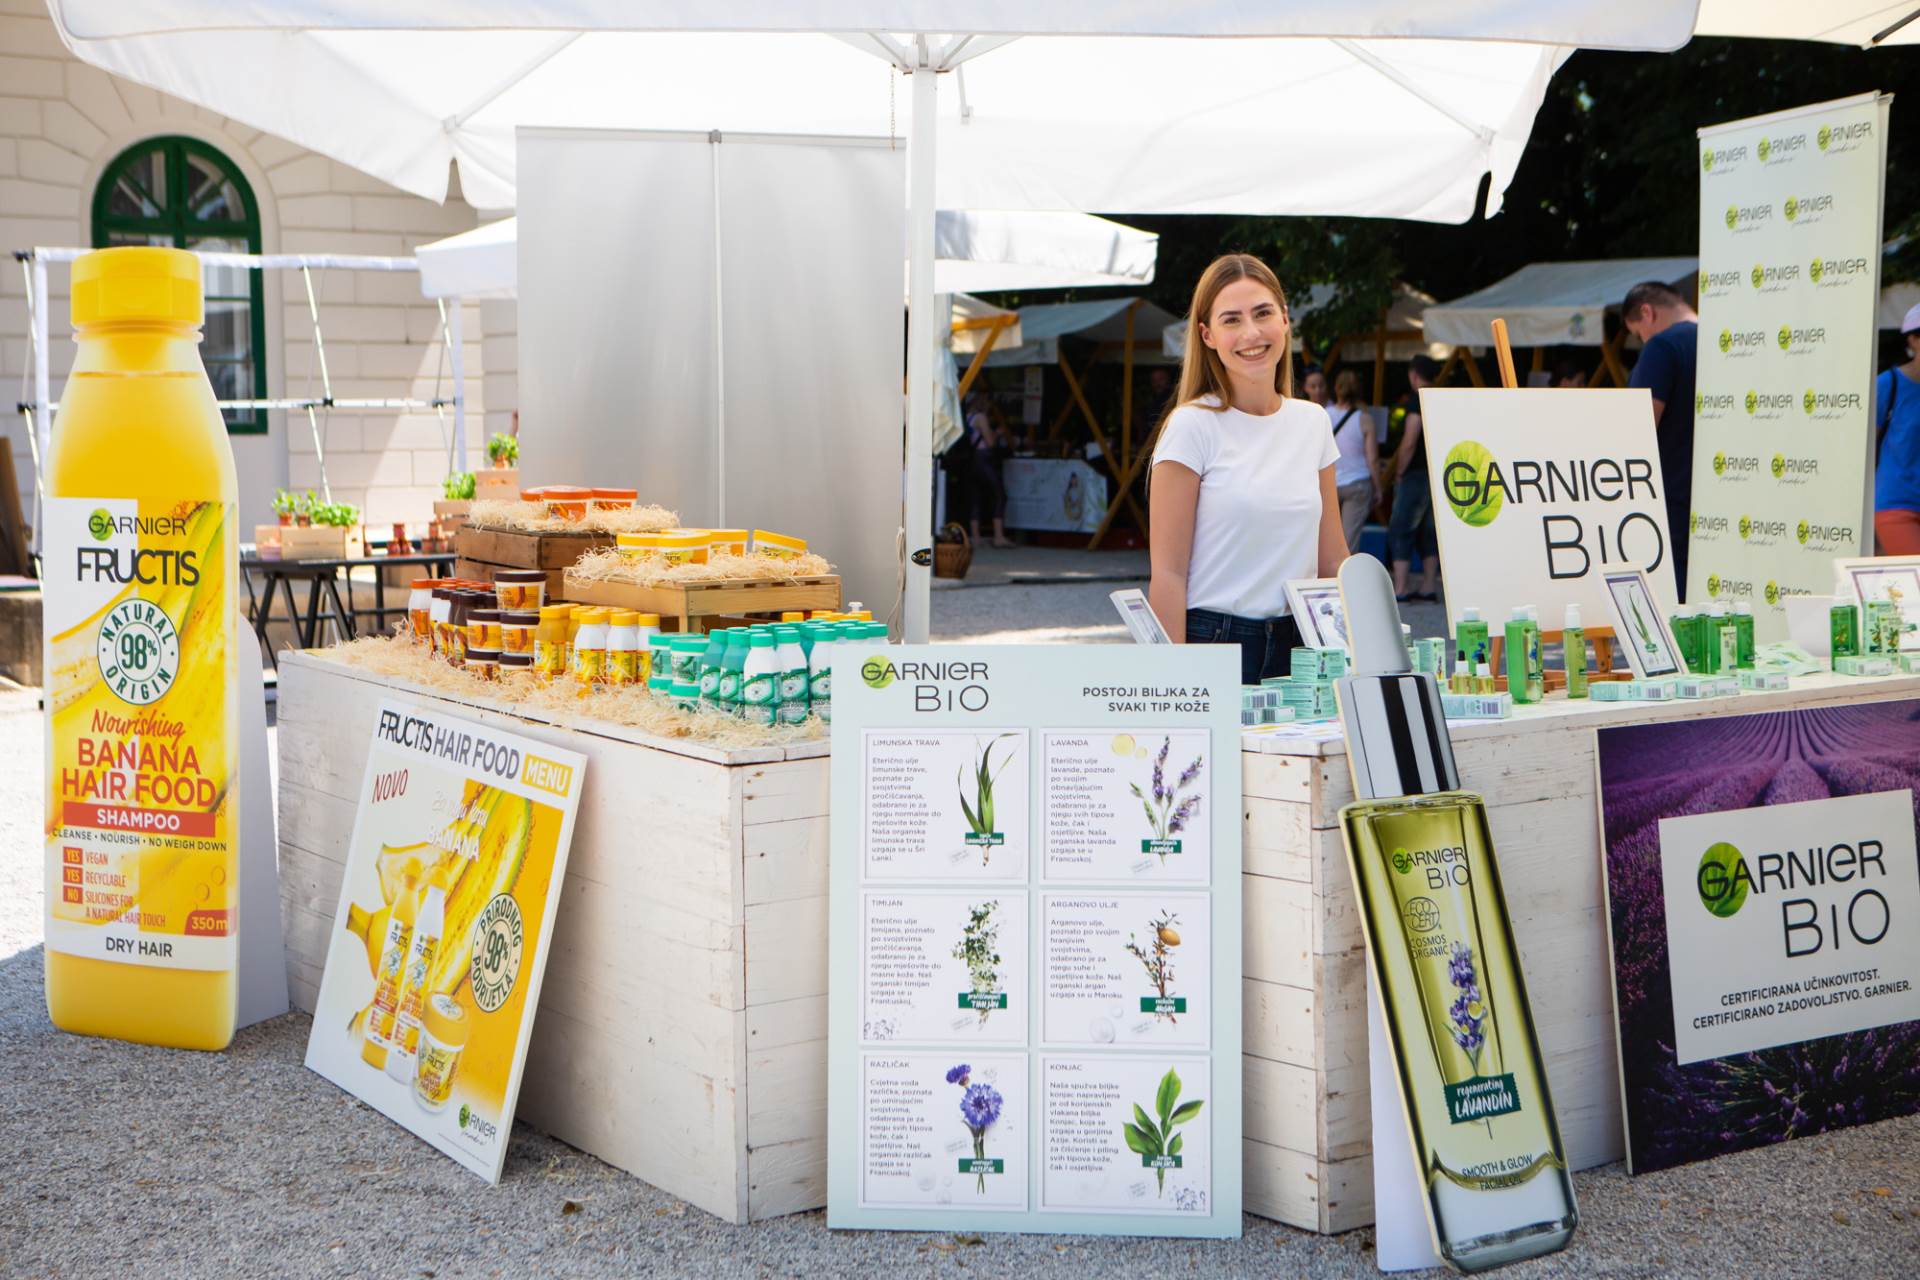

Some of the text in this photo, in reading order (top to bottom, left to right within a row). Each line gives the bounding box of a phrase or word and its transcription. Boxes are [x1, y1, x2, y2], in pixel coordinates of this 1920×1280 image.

[1817, 121, 1872, 143] GARNIER
[1758, 134, 1806, 155] GARNIER
[1703, 147, 1747, 167] GARNIER
[1726, 205, 1772, 224] GARNIER
[1784, 195, 1833, 216] GARNIER
[1752, 265, 1800, 285] GARNIER
[1810, 258, 1867, 278] GARNIER
[1719, 331, 1765, 347] GARNIER
[1778, 327, 1825, 345] GARNIER
[1696, 395, 1734, 409] ARNIER
[1745, 394, 1793, 409] GARNIER
[1803, 393, 1860, 409] GARNIER
[1713, 456, 1759, 471] GARNIER
[1771, 457, 1818, 474] GARNIER
[1443, 459, 1657, 506] GARNIER
[89, 516, 186, 535] GARNIER
[1691, 516, 1728, 531] ARNIER
[1739, 520, 1786, 536] GARNIER
[1797, 523, 1853, 541] GARNIER
[1543, 512, 1663, 579] BIO
[77, 548, 199, 586] FRUCTIS
[1707, 579, 1753, 596] GARNIER
[102, 603, 173, 645] NATURAL
[121, 633, 157, 670] 98%
[861, 661, 989, 681] GARNIER
[106, 665, 172, 700] ORIGIN
[1083, 687, 1210, 698] POSTOJI BILJKA ZA
[915, 685, 989, 712] BIO
[1108, 699, 1210, 713] SVAKI TIP KOŽE
[91, 709, 186, 752] Nourishing
[79, 738, 200, 774] BANANA
[378, 710, 568, 792] FRUCTIS HAIR FOOD MENU
[63, 768, 216, 806] HAIR FOOD
[373, 768, 408, 803] NOVO
[97, 810, 180, 830] SHAMPOO
[53, 829, 227, 851] CLEANSE NOURISH NO WEIGH DOWN
[67, 849, 108, 864] YES VEGAN
[1392, 846, 1465, 869] GARNIER
[67, 869, 126, 886] YES RECYCLABLE
[1426, 865, 1470, 890] BIO
[1697, 839, 1887, 902] GARNIER
[68, 890, 132, 906] NO SILICONES FOR
[86, 907, 165, 927] A NATURAL HAIR TOUCH
[480, 899, 522, 947] PRIRODNOG
[1782, 888, 1890, 958] BIO
[106, 937, 172, 957] DRY HAIR
[1721, 968, 1880, 1006] CERTIFICIRANA UČINKOVITOST.
[1693, 980, 1912, 1029] CERTIFICIRANO ZADOVOLJSTVO. GARNIER.
[870, 1060, 910, 1068] RAZLIČAK
[1457, 1079, 1504, 1097] regenerating
[1455, 1092, 1513, 1118] LAVANDIN
[1462, 1154, 1533, 1178] SMOOTH & GLOW
